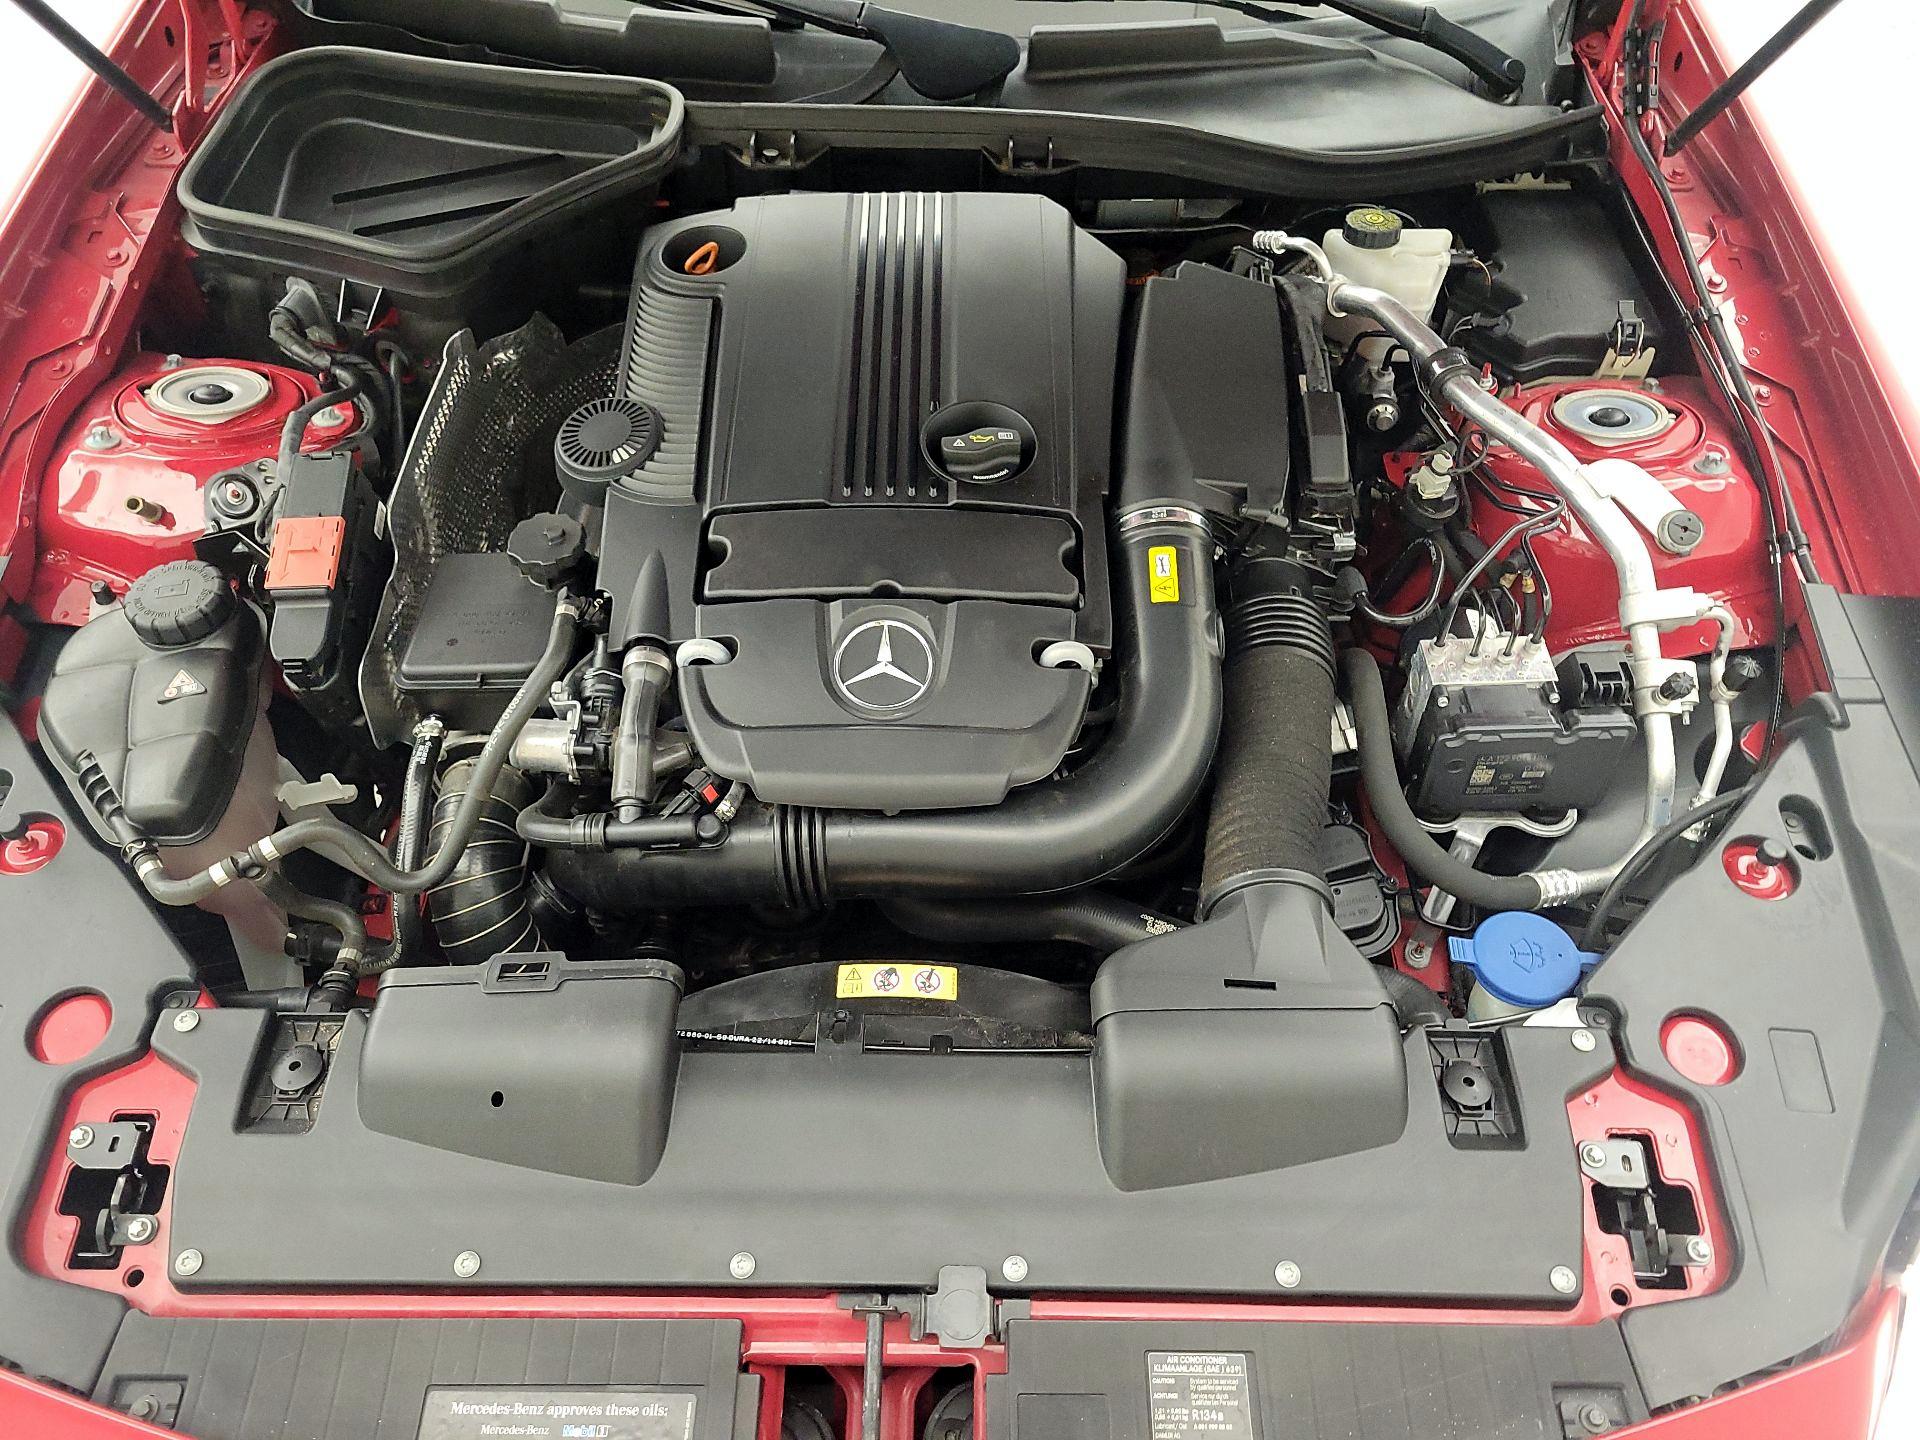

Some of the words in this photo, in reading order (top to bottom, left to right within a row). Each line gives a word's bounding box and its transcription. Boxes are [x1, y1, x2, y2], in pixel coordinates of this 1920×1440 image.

[1166, 1356, 1179, 1364] AIR
[1179, 1356, 1228, 1364] CONDITIONER
[1153, 1365, 1203, 1373] KLIMAANLAGE
[450, 1401, 545, 1417] Mercedes-Benz
[546, 1403, 605, 1418] approves
[606, 1402, 640, 1417] these
[642, 1403, 669, 1417] oils:
[480, 1424, 550, 1436] Mercedes-Benz
[562, 1424, 596, 1437] Mobil
